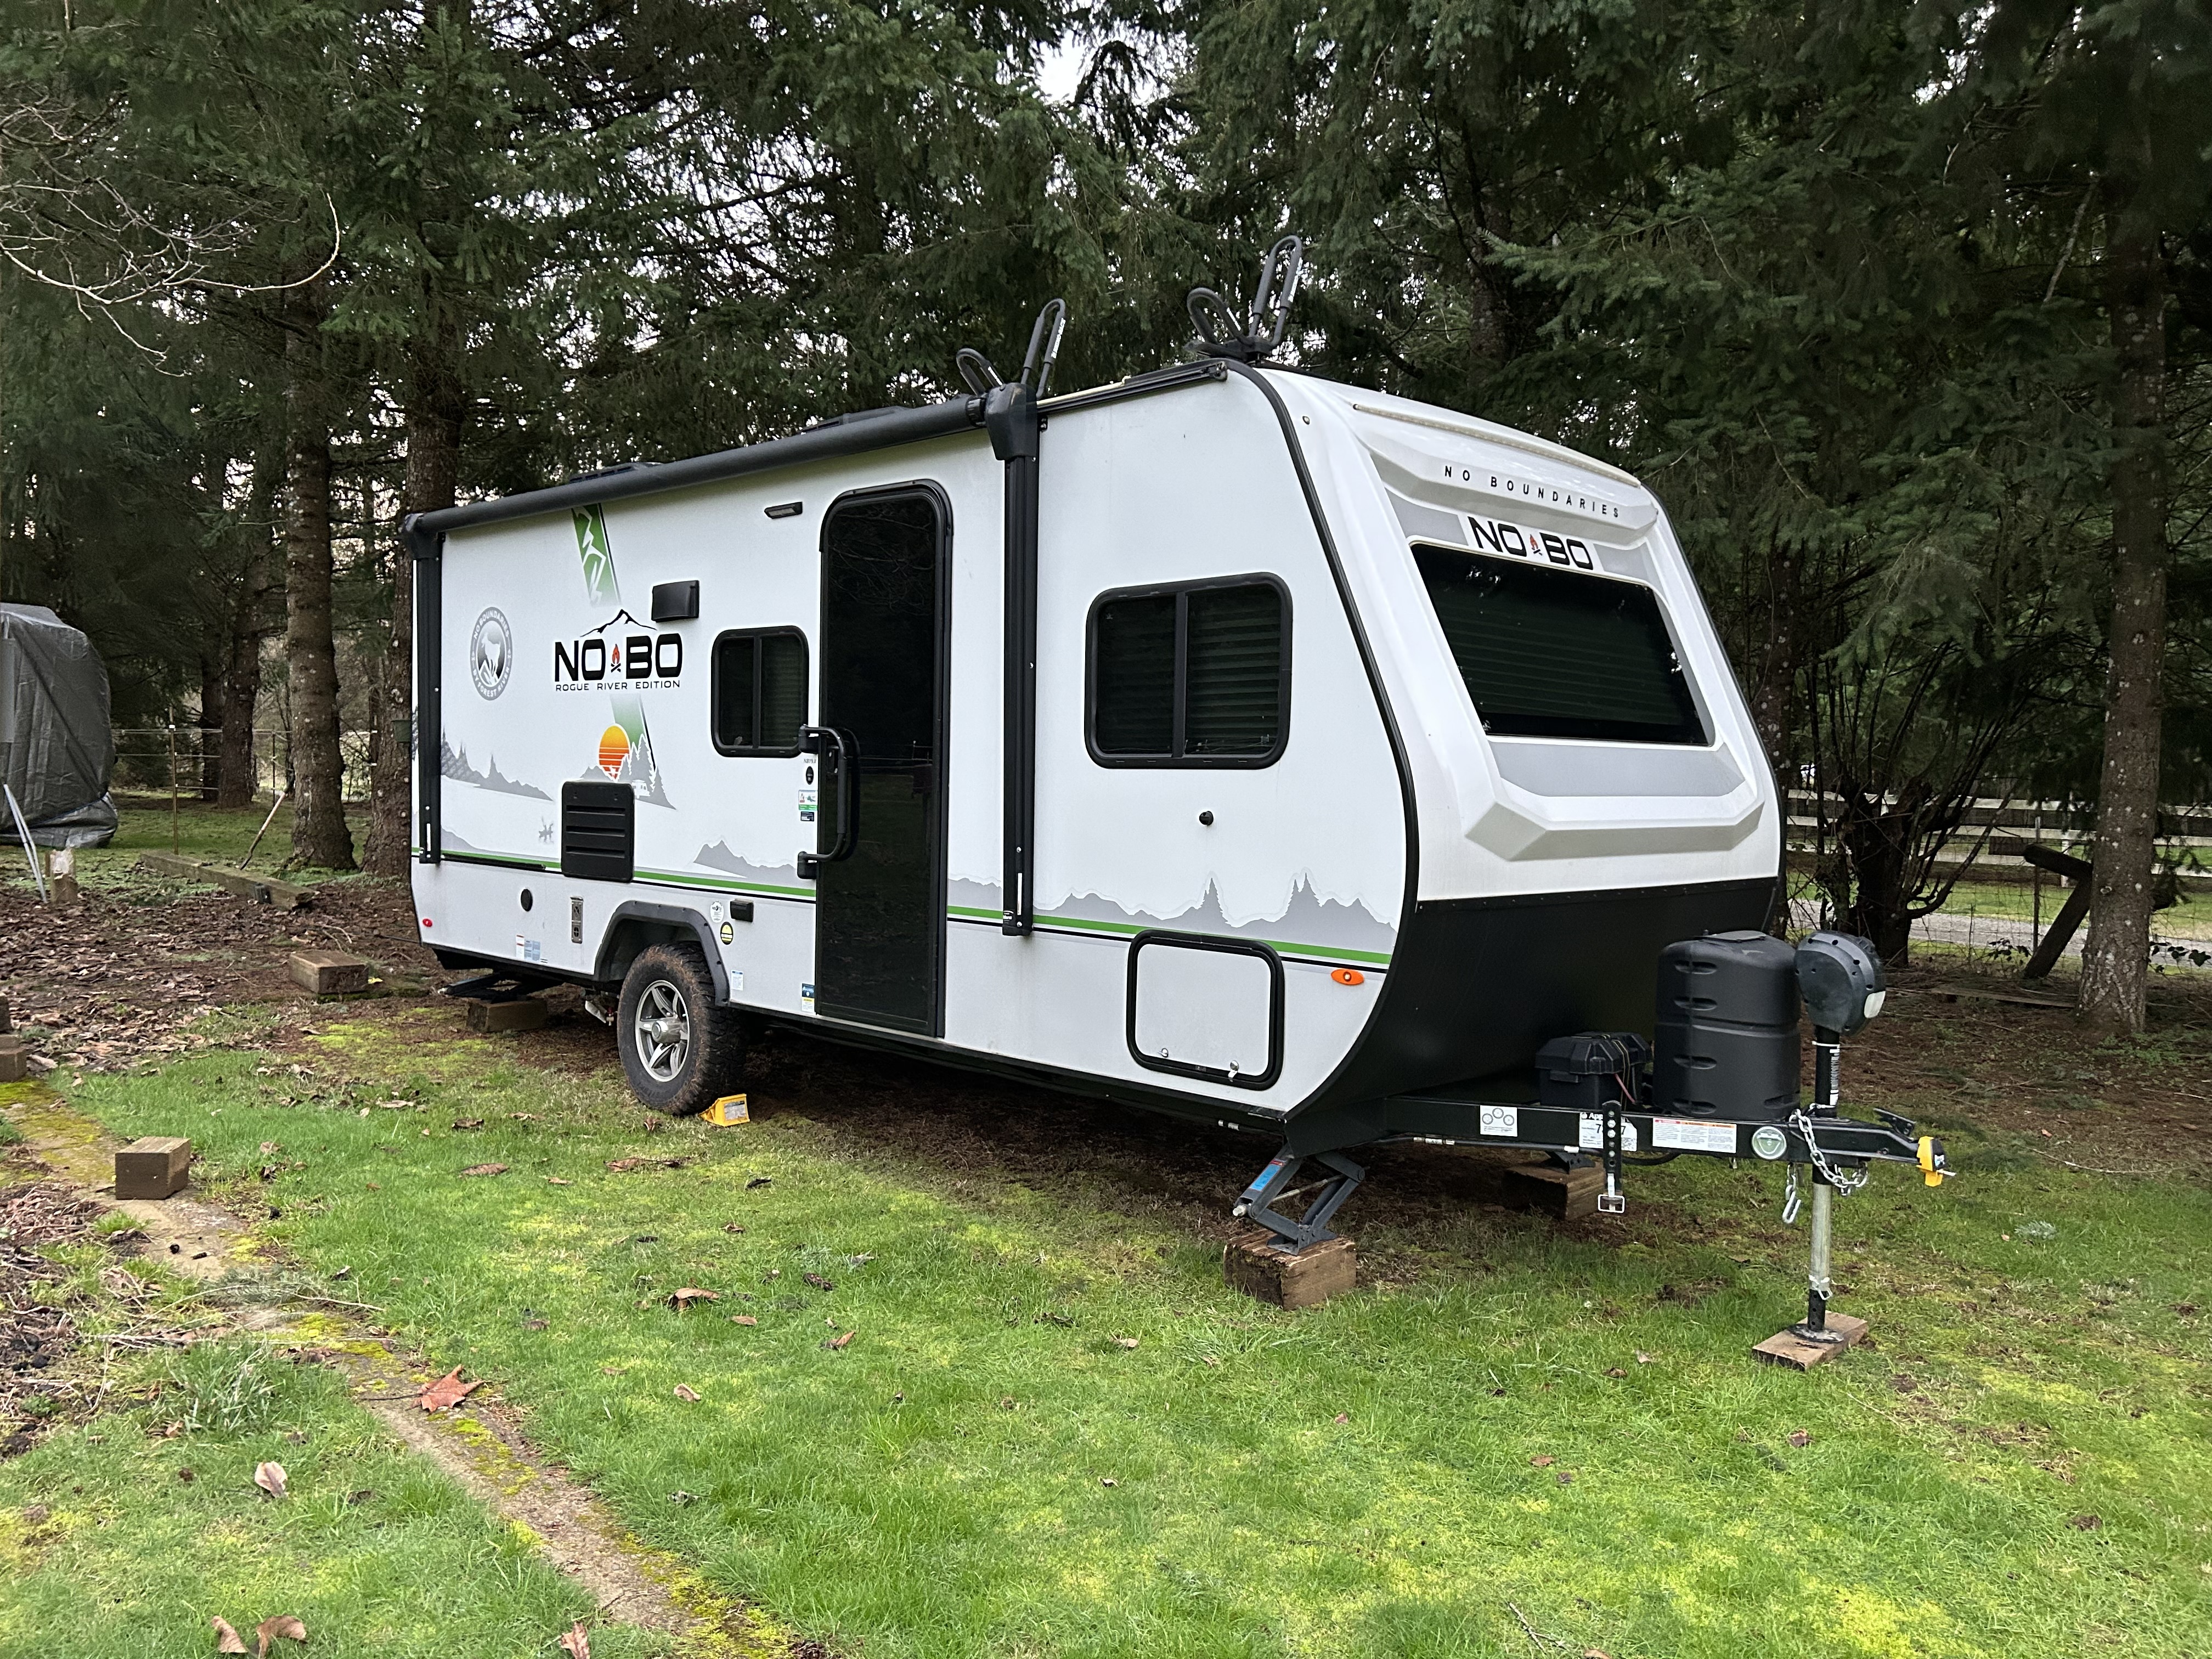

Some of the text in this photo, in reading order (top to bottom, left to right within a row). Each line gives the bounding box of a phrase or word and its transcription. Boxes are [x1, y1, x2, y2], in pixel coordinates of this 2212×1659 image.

[1444, 465, 1618, 518] NO BOUNDARIES
[1467, 516, 1593, 571] NO BO
[473, 610, 510, 639] NO BOUNDARIES
[555, 633, 683, 682] NO BO
[472, 665, 510, 697] BY FOREST RIVER
[555, 680, 680, 691] ROGUE RIVER EDITION
